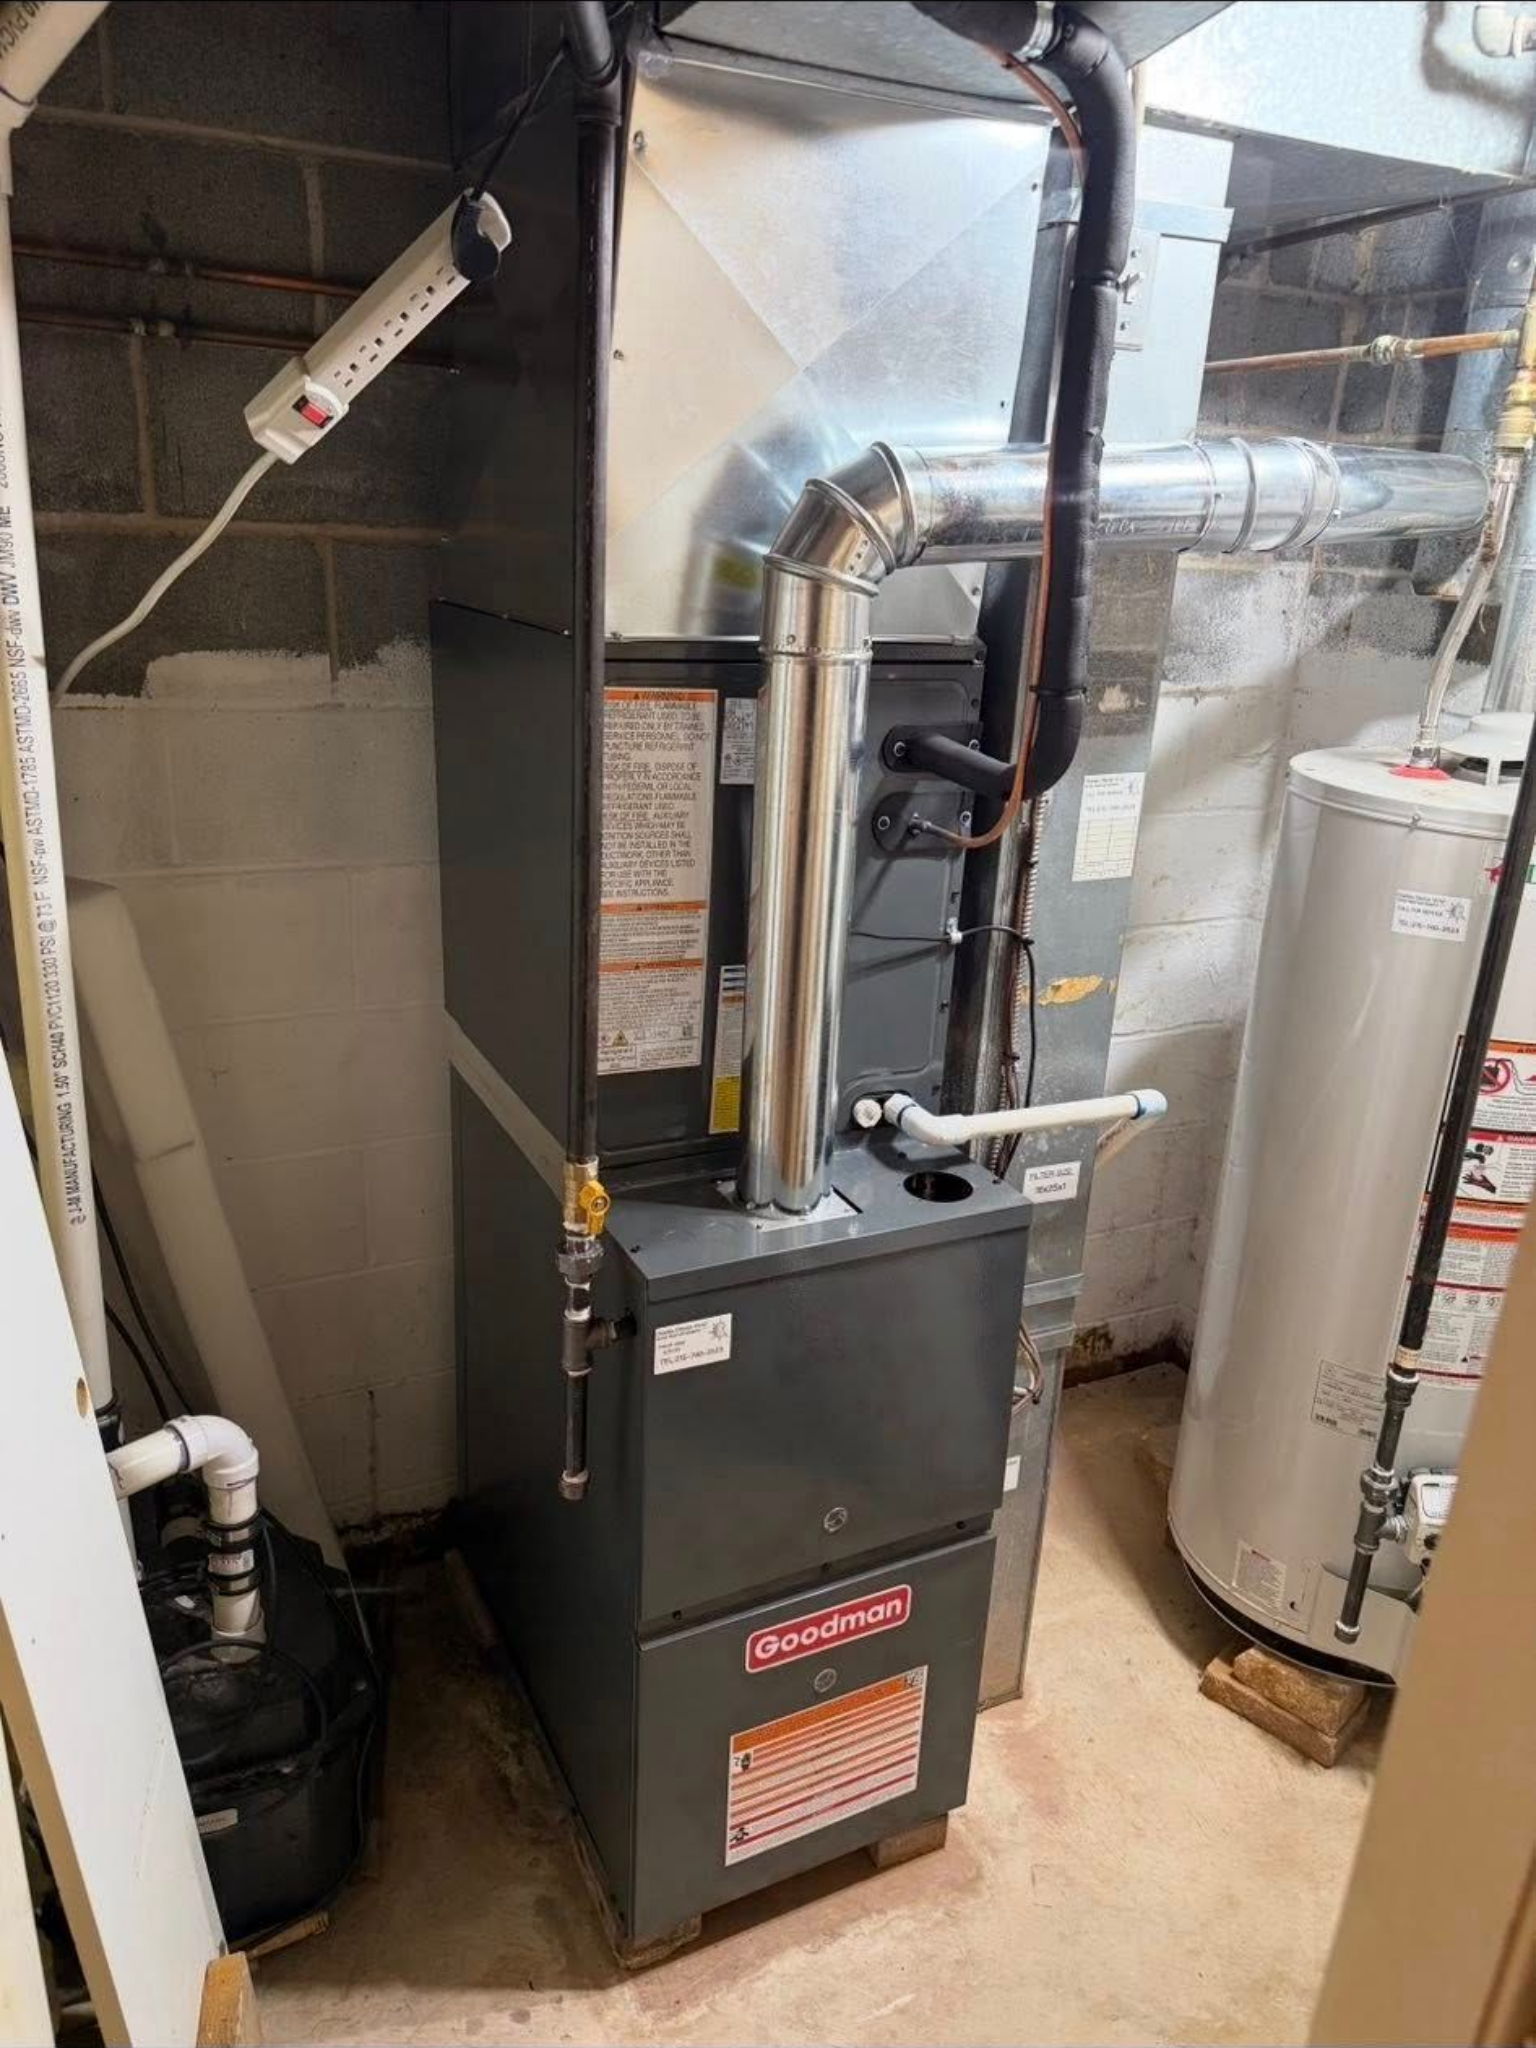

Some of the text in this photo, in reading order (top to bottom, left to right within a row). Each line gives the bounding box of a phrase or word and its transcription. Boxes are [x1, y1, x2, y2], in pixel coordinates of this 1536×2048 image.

[0, 571, 20, 606] DWV
[5, 609, 26, 668] NSF-dwv
[9, 671, 34, 754] ASTMD-2665
[19, 756, 44, 836] ASTMD-1785
[39, 935, 57, 954] PSI
[40, 957, 58, 979] 330
[44, 980, 64, 1030] PVC1120
[49, 1031, 67, 1069] SCH40
[56, 1103, 80, 1195] MANUFACTURING
[754, 1598, 903, 1660] Goodman
